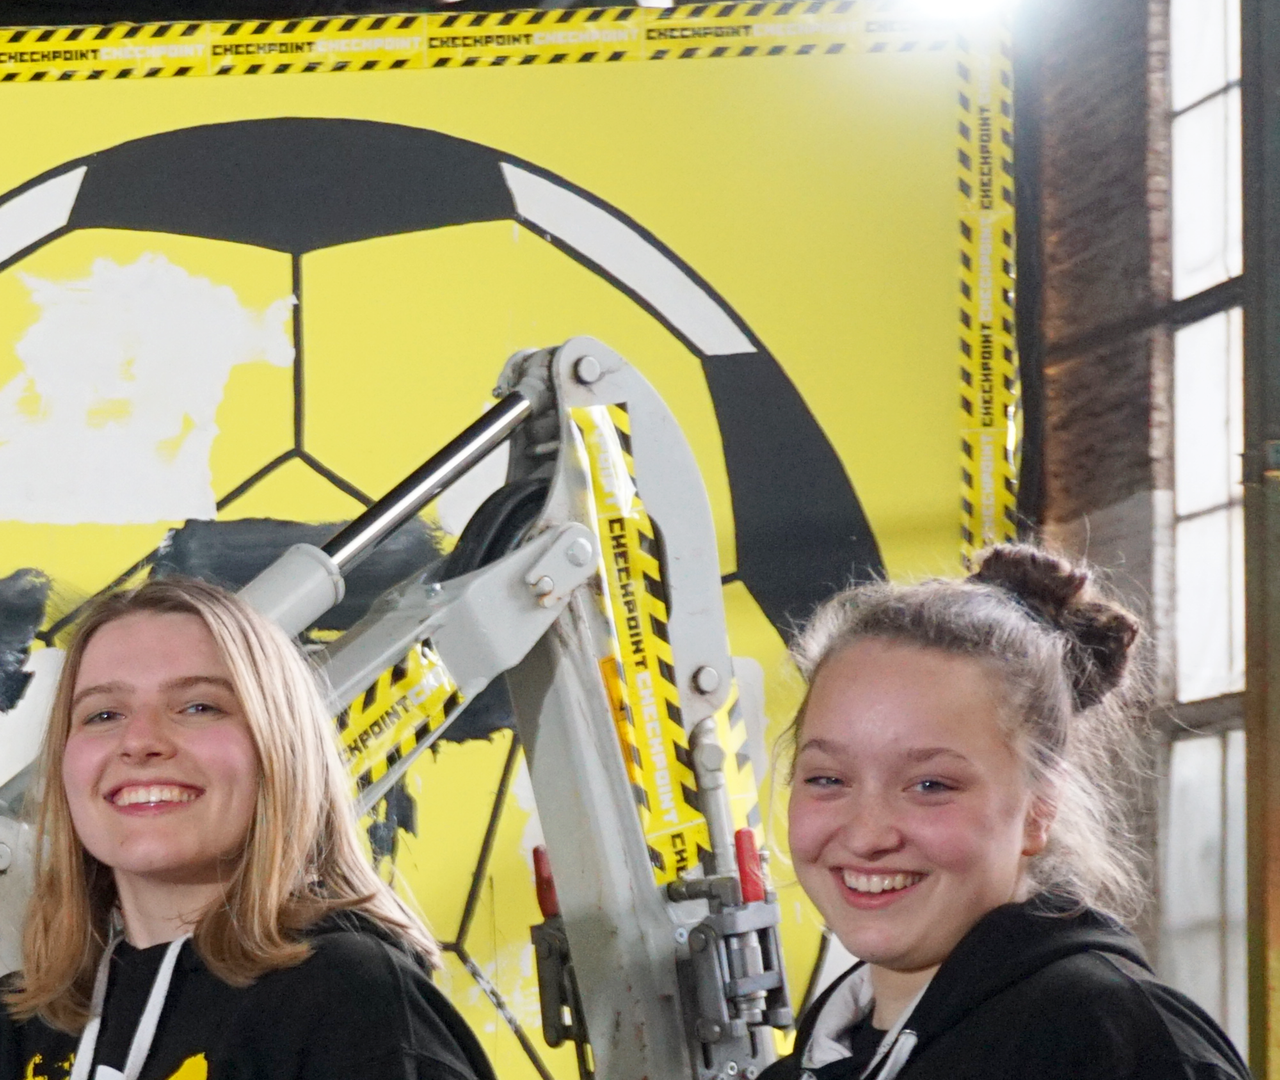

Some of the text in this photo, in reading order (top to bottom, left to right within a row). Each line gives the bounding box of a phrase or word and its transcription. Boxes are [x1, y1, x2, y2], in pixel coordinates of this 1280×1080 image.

[100, 44, 206, 61] CHECKPOINT
[212, 41, 315, 56] CHECKPOINT
[315, 36, 421, 52] CHECKPOINT
[429, 33, 533, 48] CHECKPOINT
[646, 25, 752, 40] CHECKPOINT
[980, 323, 994, 427] CHECKPOINT
[608, 517, 679, 824] CHECKPOINT CHECKPOINT
